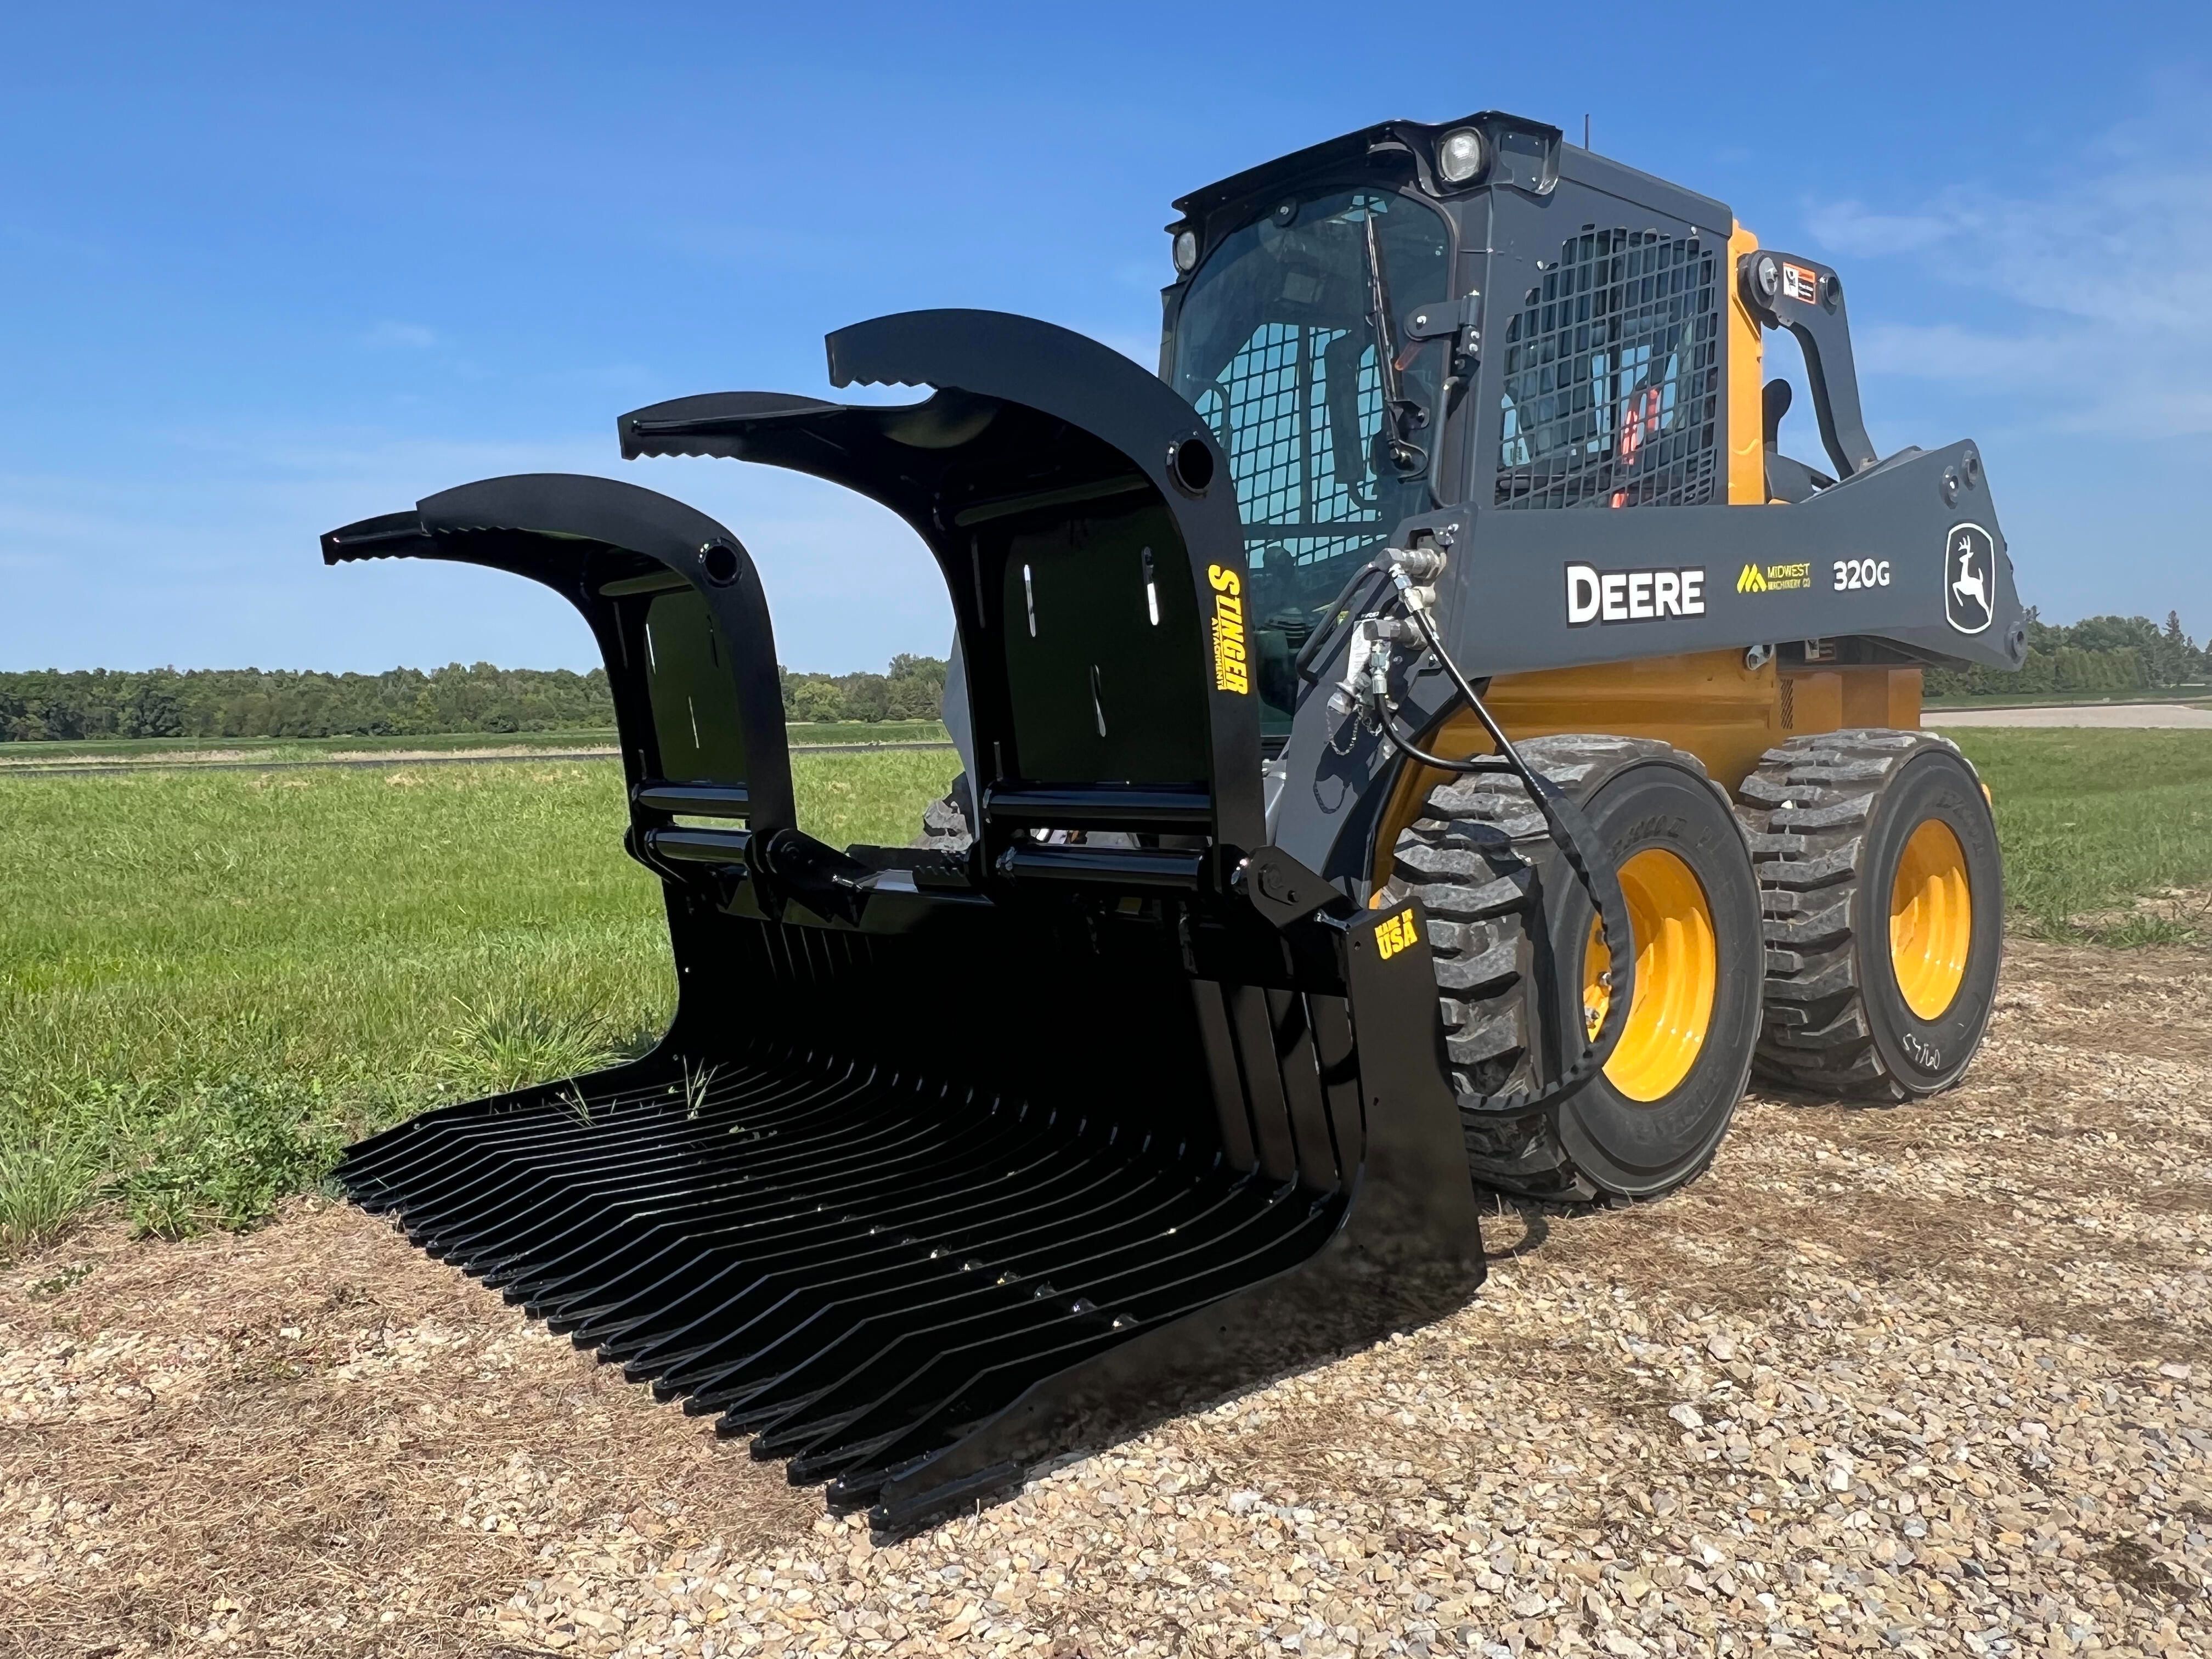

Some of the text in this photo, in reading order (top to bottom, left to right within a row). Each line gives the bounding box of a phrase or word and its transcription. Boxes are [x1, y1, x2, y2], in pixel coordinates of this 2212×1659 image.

[1768, 563, 1810, 578] MIDWEST
[1833, 558, 1890, 591] 320G
[1566, 565, 1705, 624] DEERE
[1208, 565, 1248, 695] STINGER
[1377, 921, 1418, 960] USA
